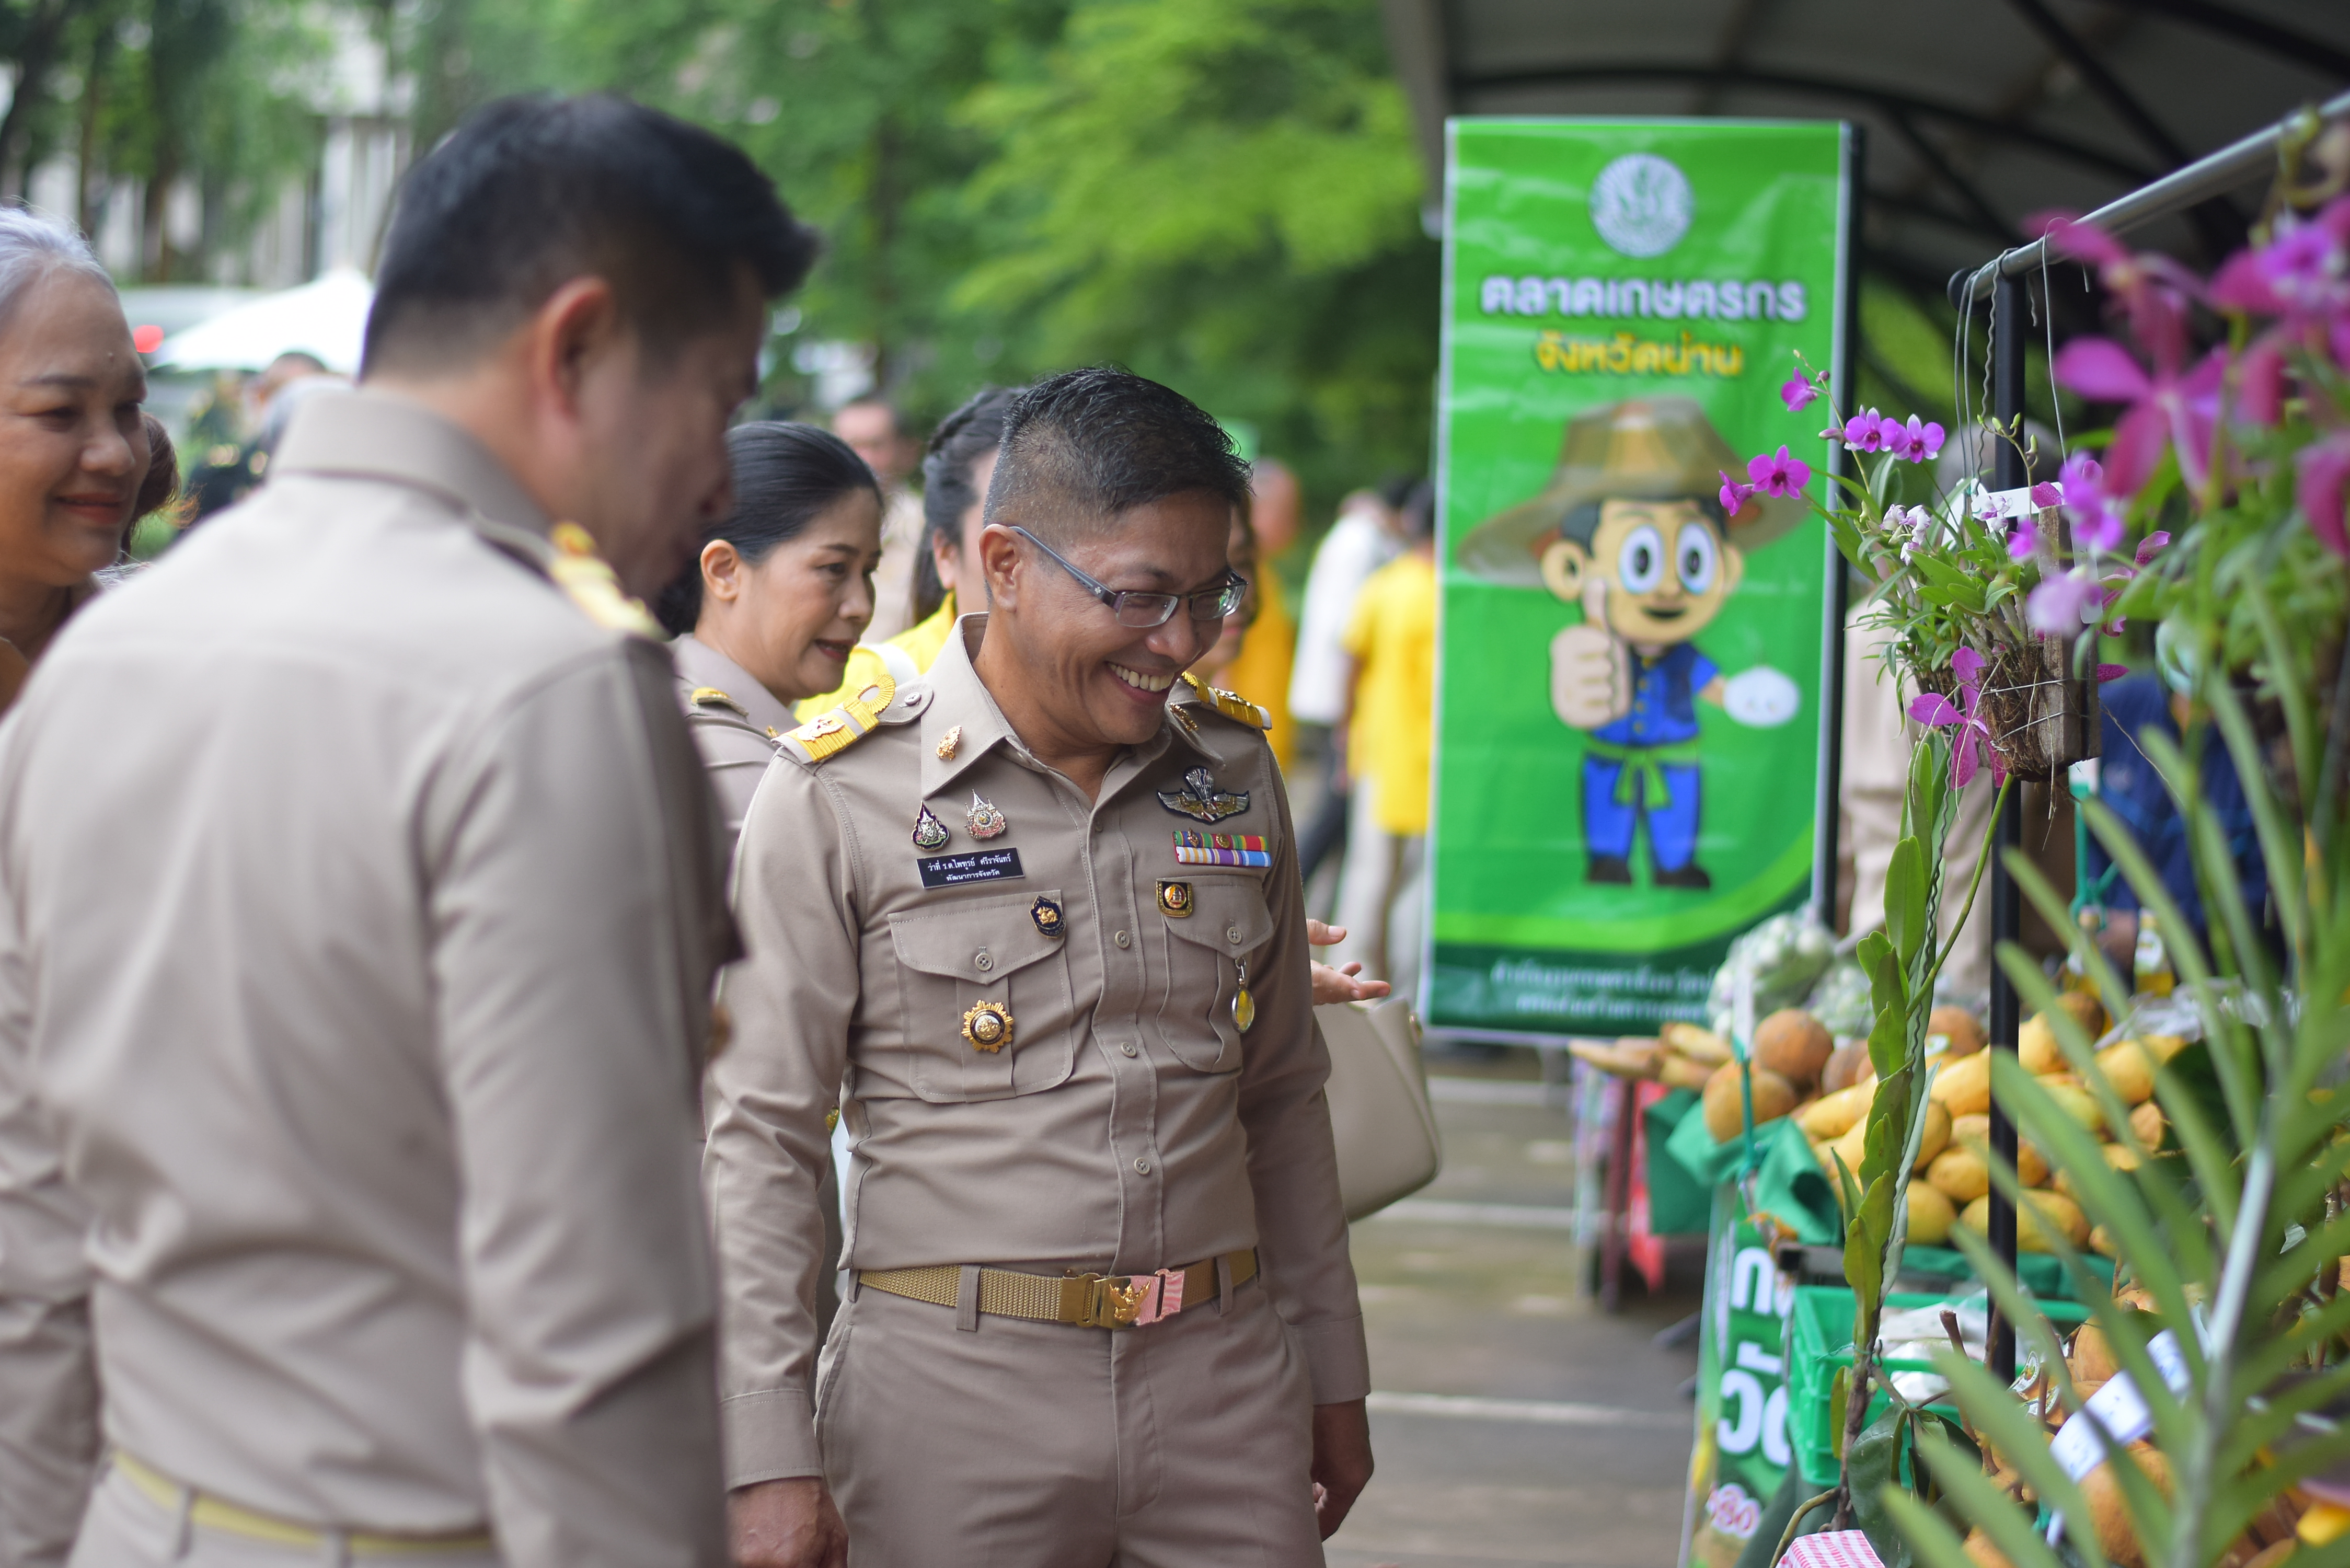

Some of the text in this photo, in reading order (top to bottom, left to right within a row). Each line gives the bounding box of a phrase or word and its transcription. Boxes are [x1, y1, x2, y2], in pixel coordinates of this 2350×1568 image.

[1536, 330, 1744, 375] จังหวัดน่าน
[928, 860, 941, 871] ว่าที่
[946, 869, 1000, 881] พัฒนาการจังหวัด
